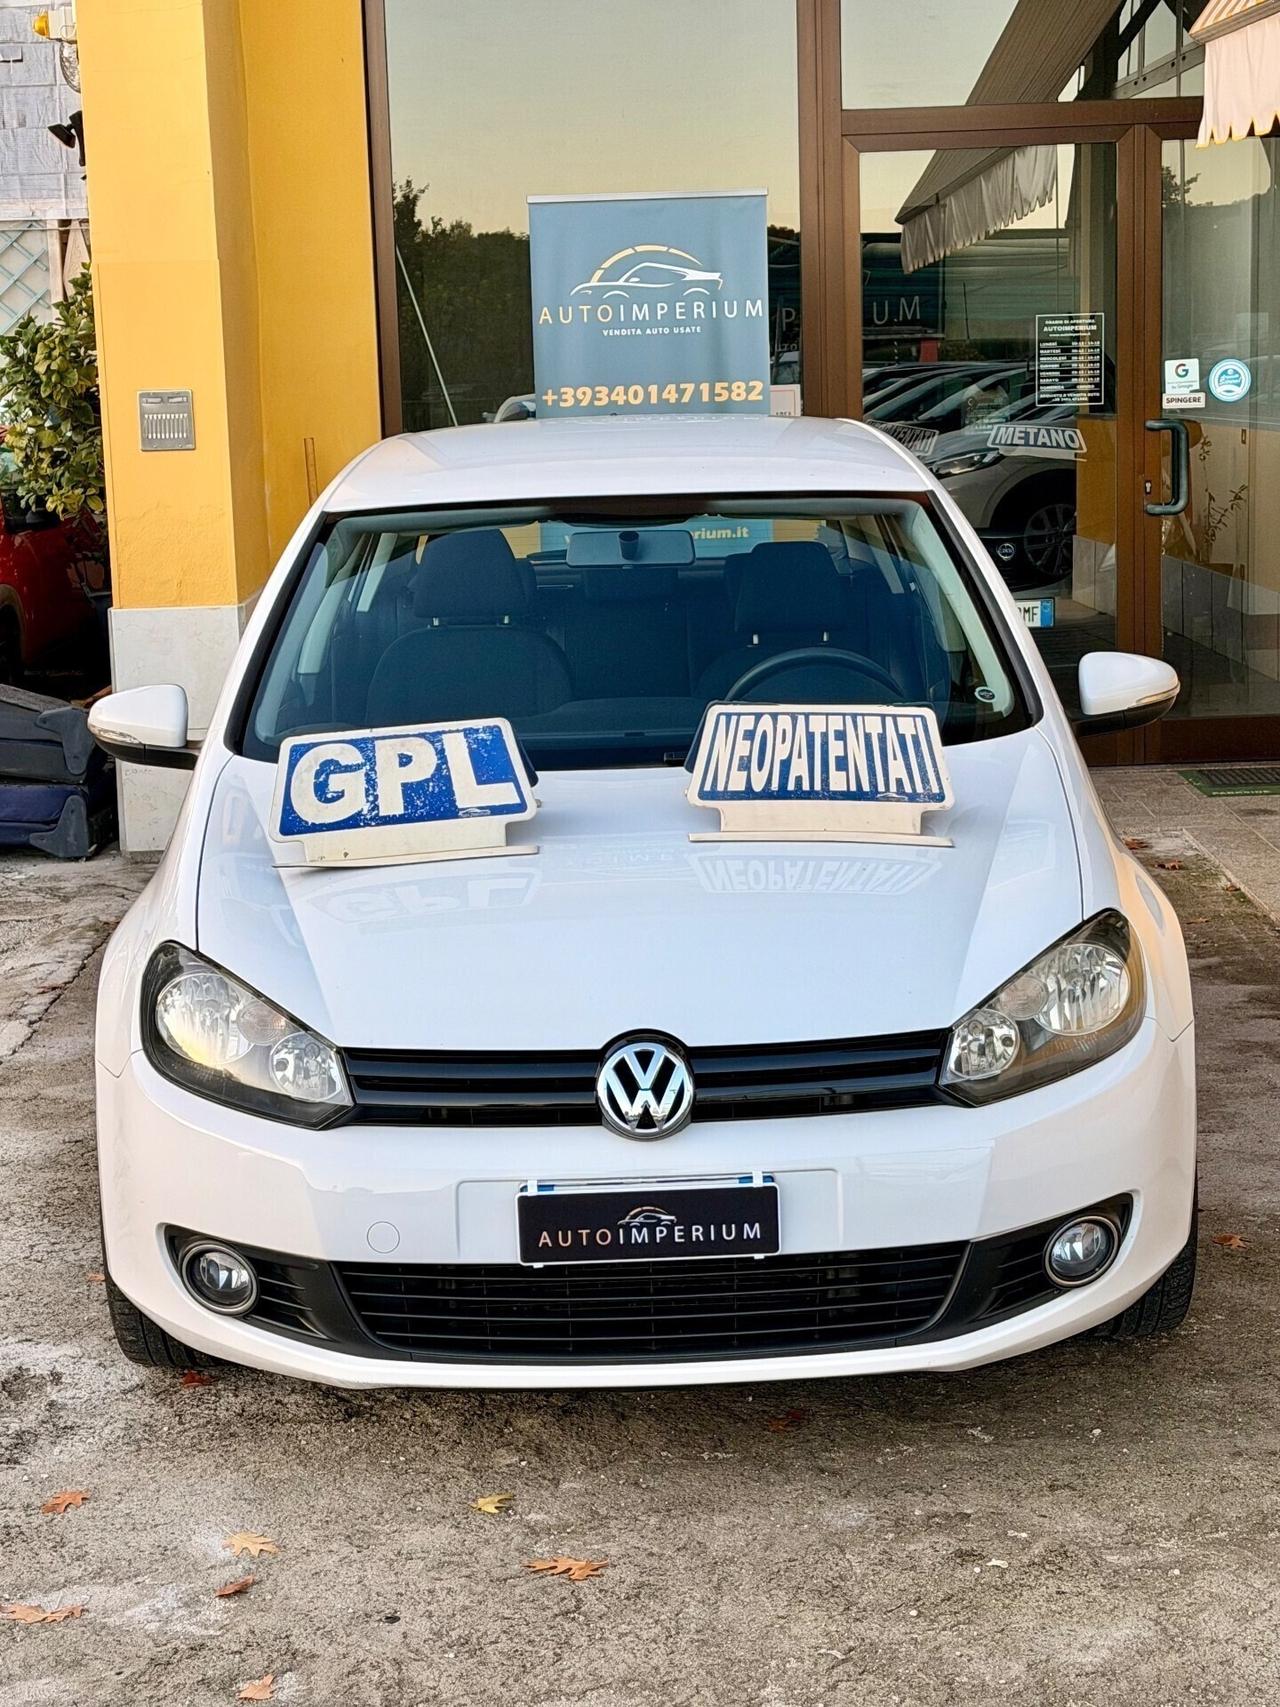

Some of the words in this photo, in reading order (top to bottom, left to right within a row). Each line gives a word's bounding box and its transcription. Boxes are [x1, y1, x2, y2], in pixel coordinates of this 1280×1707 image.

[539, 299, 763, 324] AUTOIMPERIUM
[602, 328, 642, 337] VENDITA
[645, 327, 670, 335] AUTO
[673, 326, 702, 334] USATE
[543, 381, 764, 408] +393401471582
[1165, 396, 1202, 404] SPINGERE
[995, 426, 1080, 449] METANO
[703, 713, 940, 793] NEOPATENTATI
[290, 731, 522, 825] GPL
[538, 1222, 761, 1248] AUTOIMPERIUM
